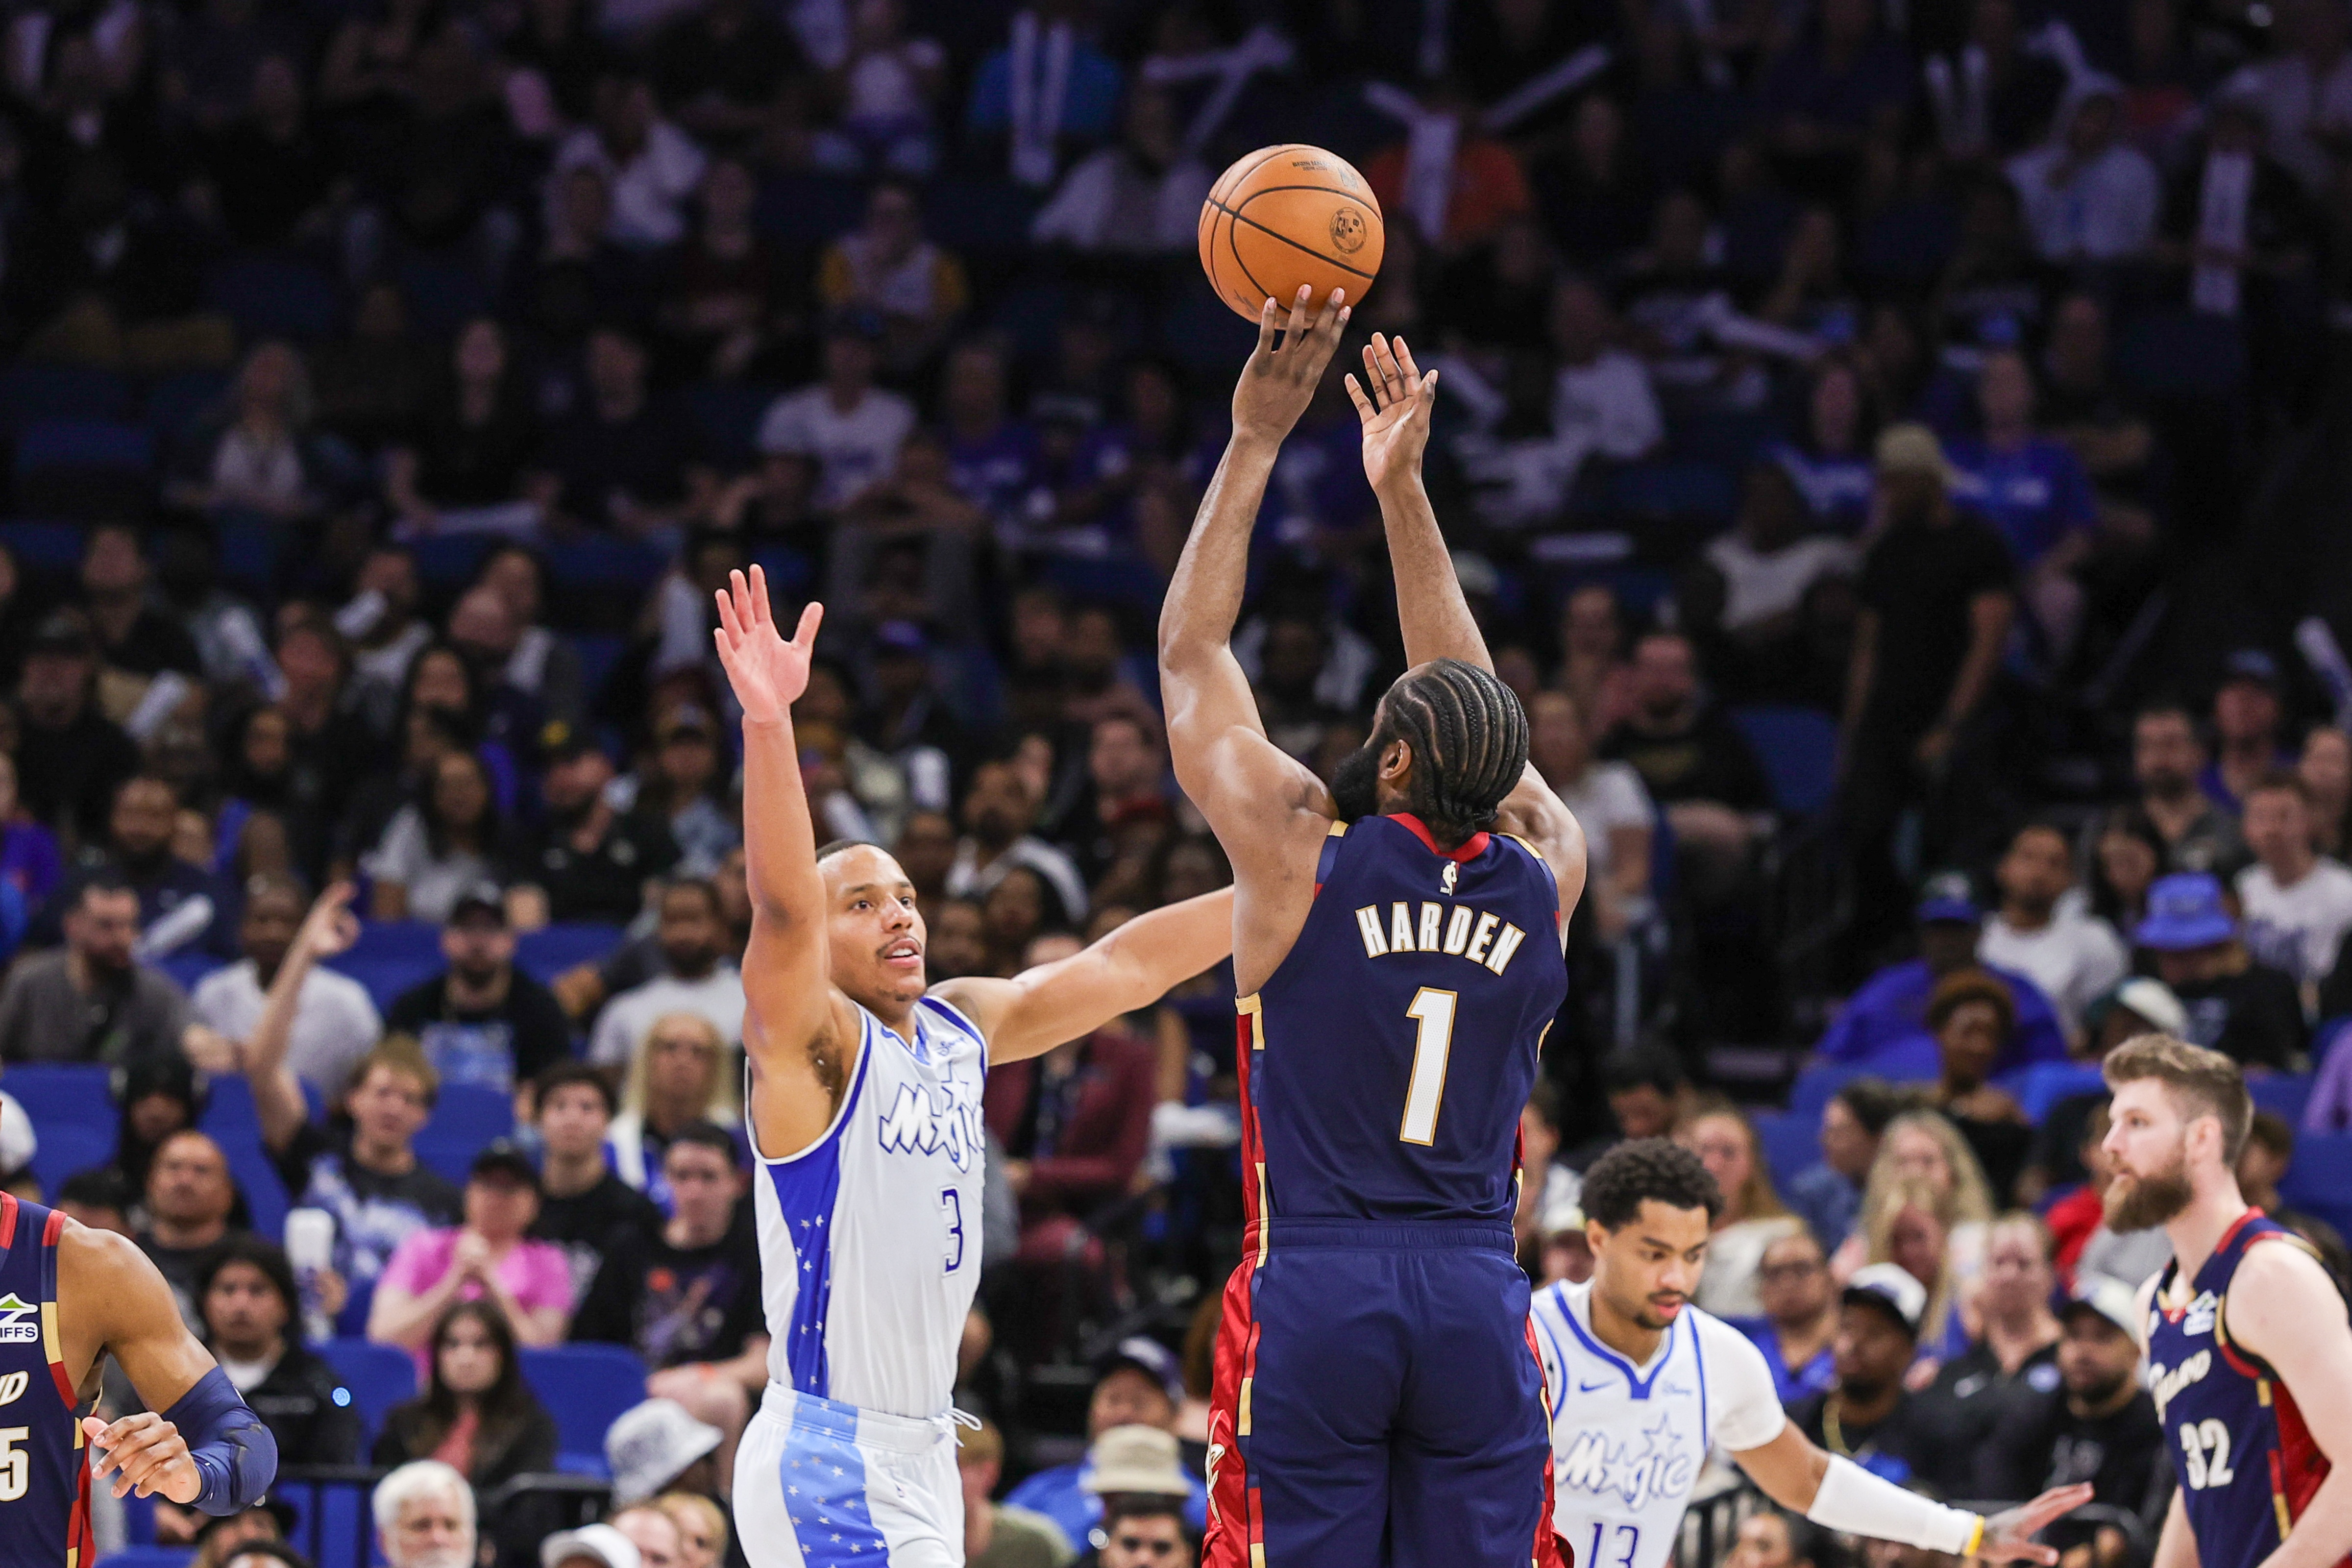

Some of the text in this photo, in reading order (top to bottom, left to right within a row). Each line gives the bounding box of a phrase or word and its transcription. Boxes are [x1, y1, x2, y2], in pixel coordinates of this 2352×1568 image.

[1355, 902, 1526, 976] HARDEN
[1399, 986, 1457, 1146] 1
[940, 1186, 964, 1276] 3
[0, 1426, 29, 1501] 5
[2180, 1418, 2234, 1491] 32
[1588, 1522, 1639, 1568] 13
